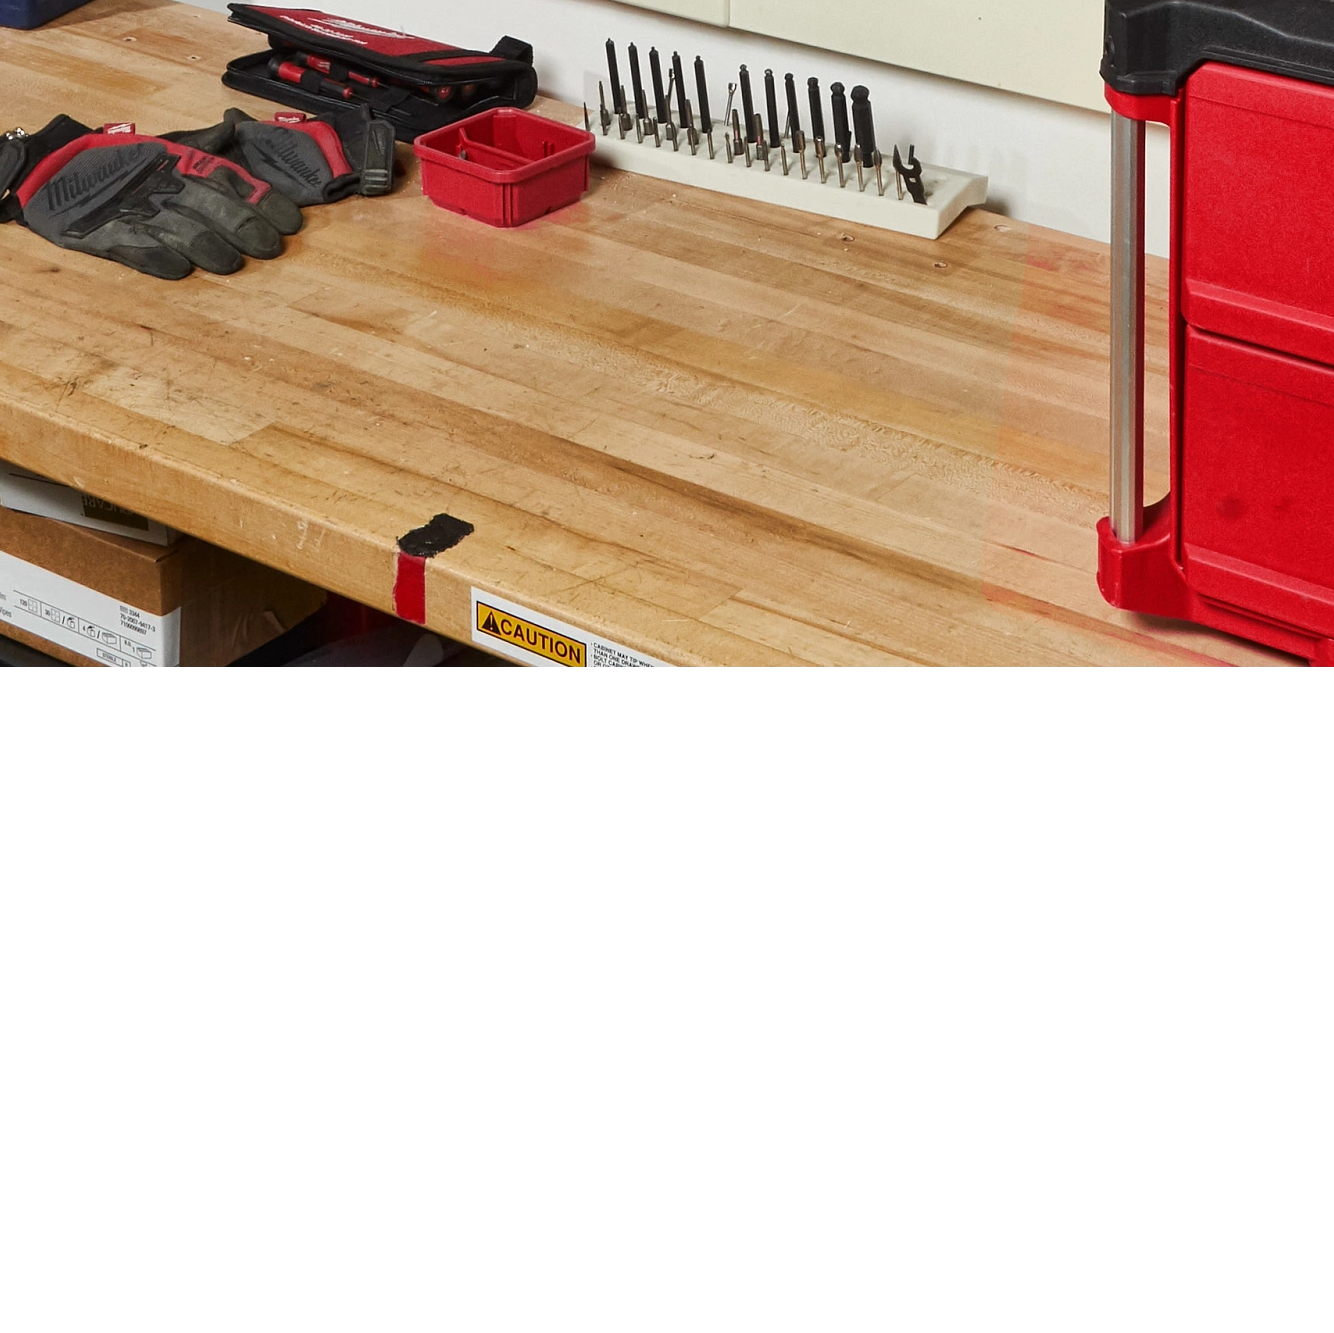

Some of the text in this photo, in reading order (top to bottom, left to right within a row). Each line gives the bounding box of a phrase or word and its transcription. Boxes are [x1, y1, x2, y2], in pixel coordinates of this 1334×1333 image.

[500, 618, 581, 664] CAUTION
[593, 642, 616, 655] CABINET
[617, 651, 629, 661] MAY
[593, 648, 608, 658] THAN
[609, 654, 621, 663] ONE
[593, 654, 607, 663] BOLT
